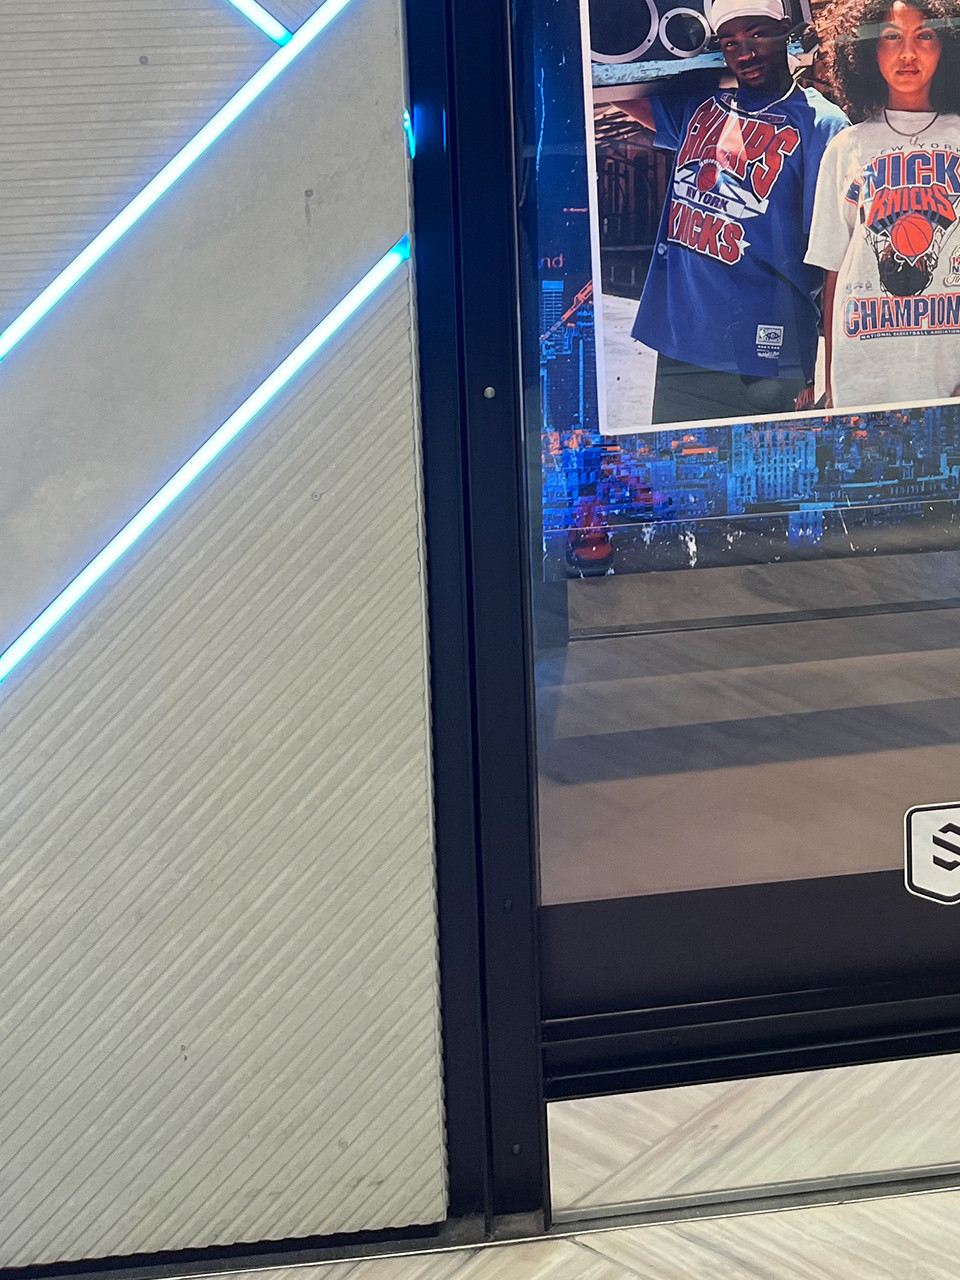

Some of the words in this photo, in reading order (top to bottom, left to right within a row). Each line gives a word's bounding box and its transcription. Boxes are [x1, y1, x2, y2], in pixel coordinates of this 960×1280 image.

[697, 189, 729, 211] YORK
[866, 185, 958, 227] KNICKS
[667, 199, 745, 265] KNICKS
